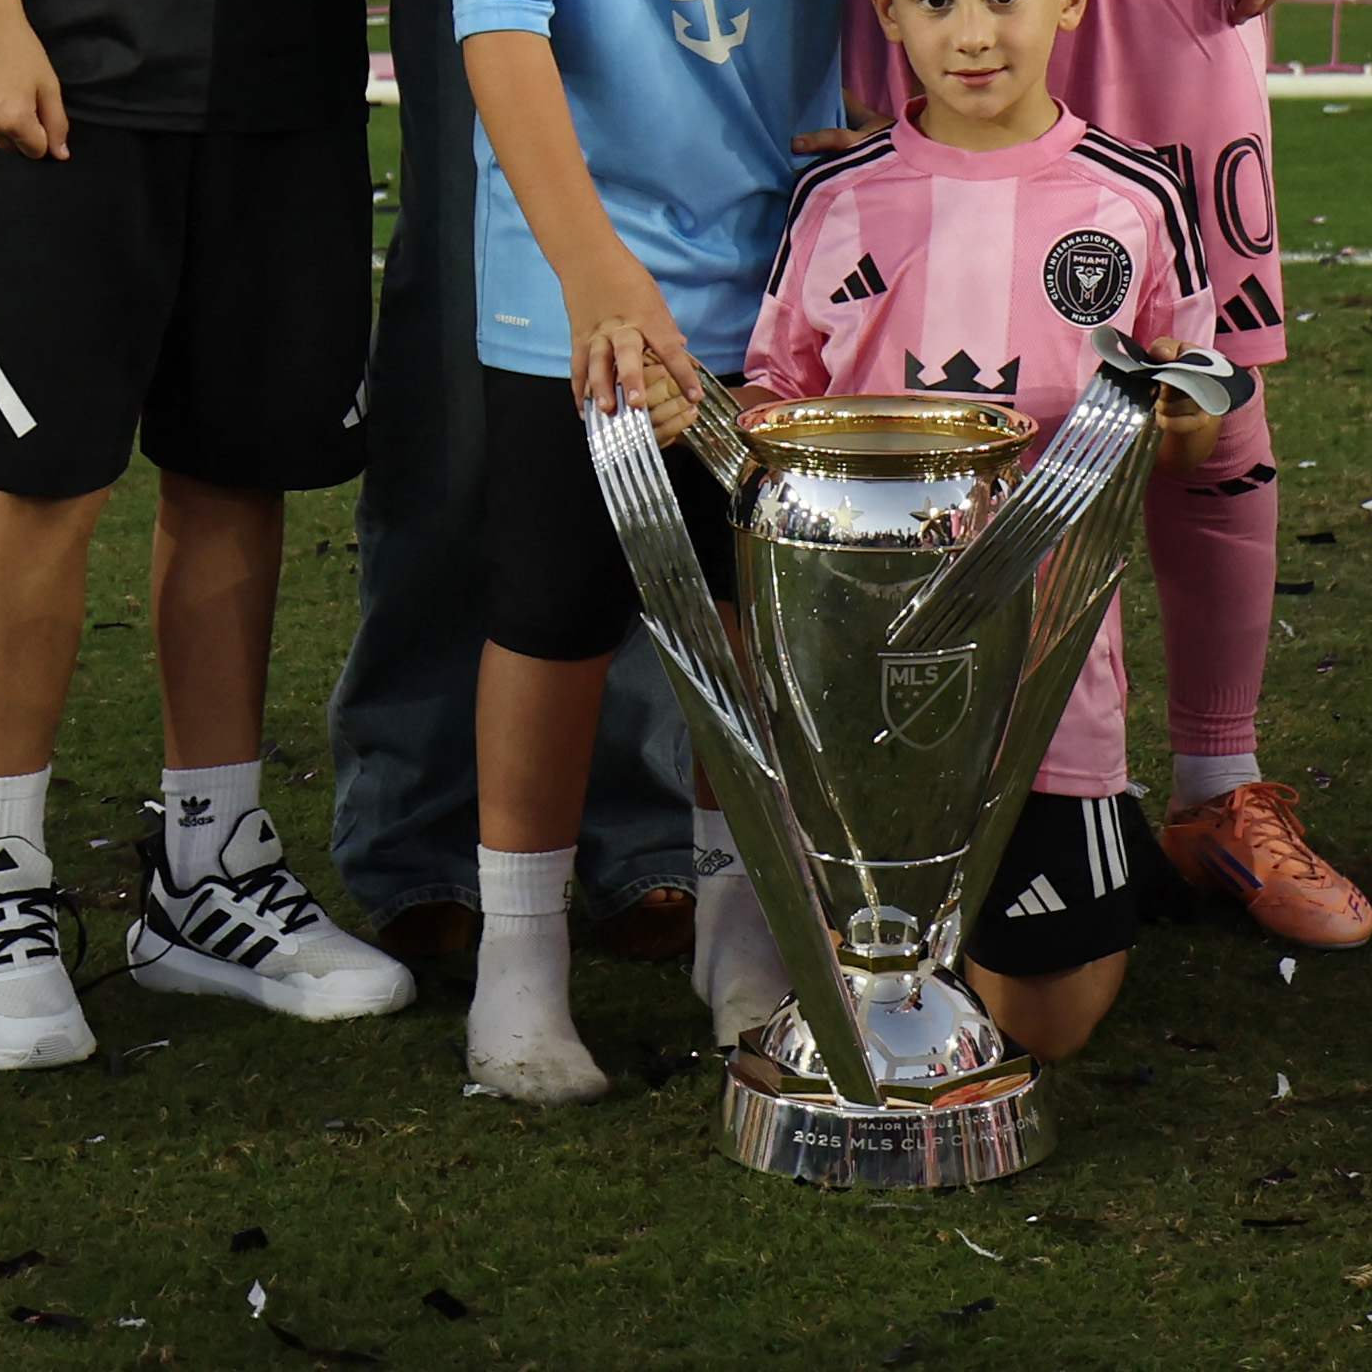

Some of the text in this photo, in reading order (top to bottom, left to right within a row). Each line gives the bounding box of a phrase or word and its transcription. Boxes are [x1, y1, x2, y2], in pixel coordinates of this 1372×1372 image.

[1046, 234, 1120, 270] INTERNACIONAL
[1072, 255, 1108, 266] MIAMI
[1118, 253, 1129, 267] DE
[1046, 274, 1059, 301] CLUB
[1070, 312, 1099, 324] MMXX
[890, 665, 939, 686] MLS
[857, 1121, 902, 1132] MAJOR
[792, 1130, 842, 1149] 2025
[849, 1137, 895, 1152] MLS
[900, 1135, 944, 1152] CUP
